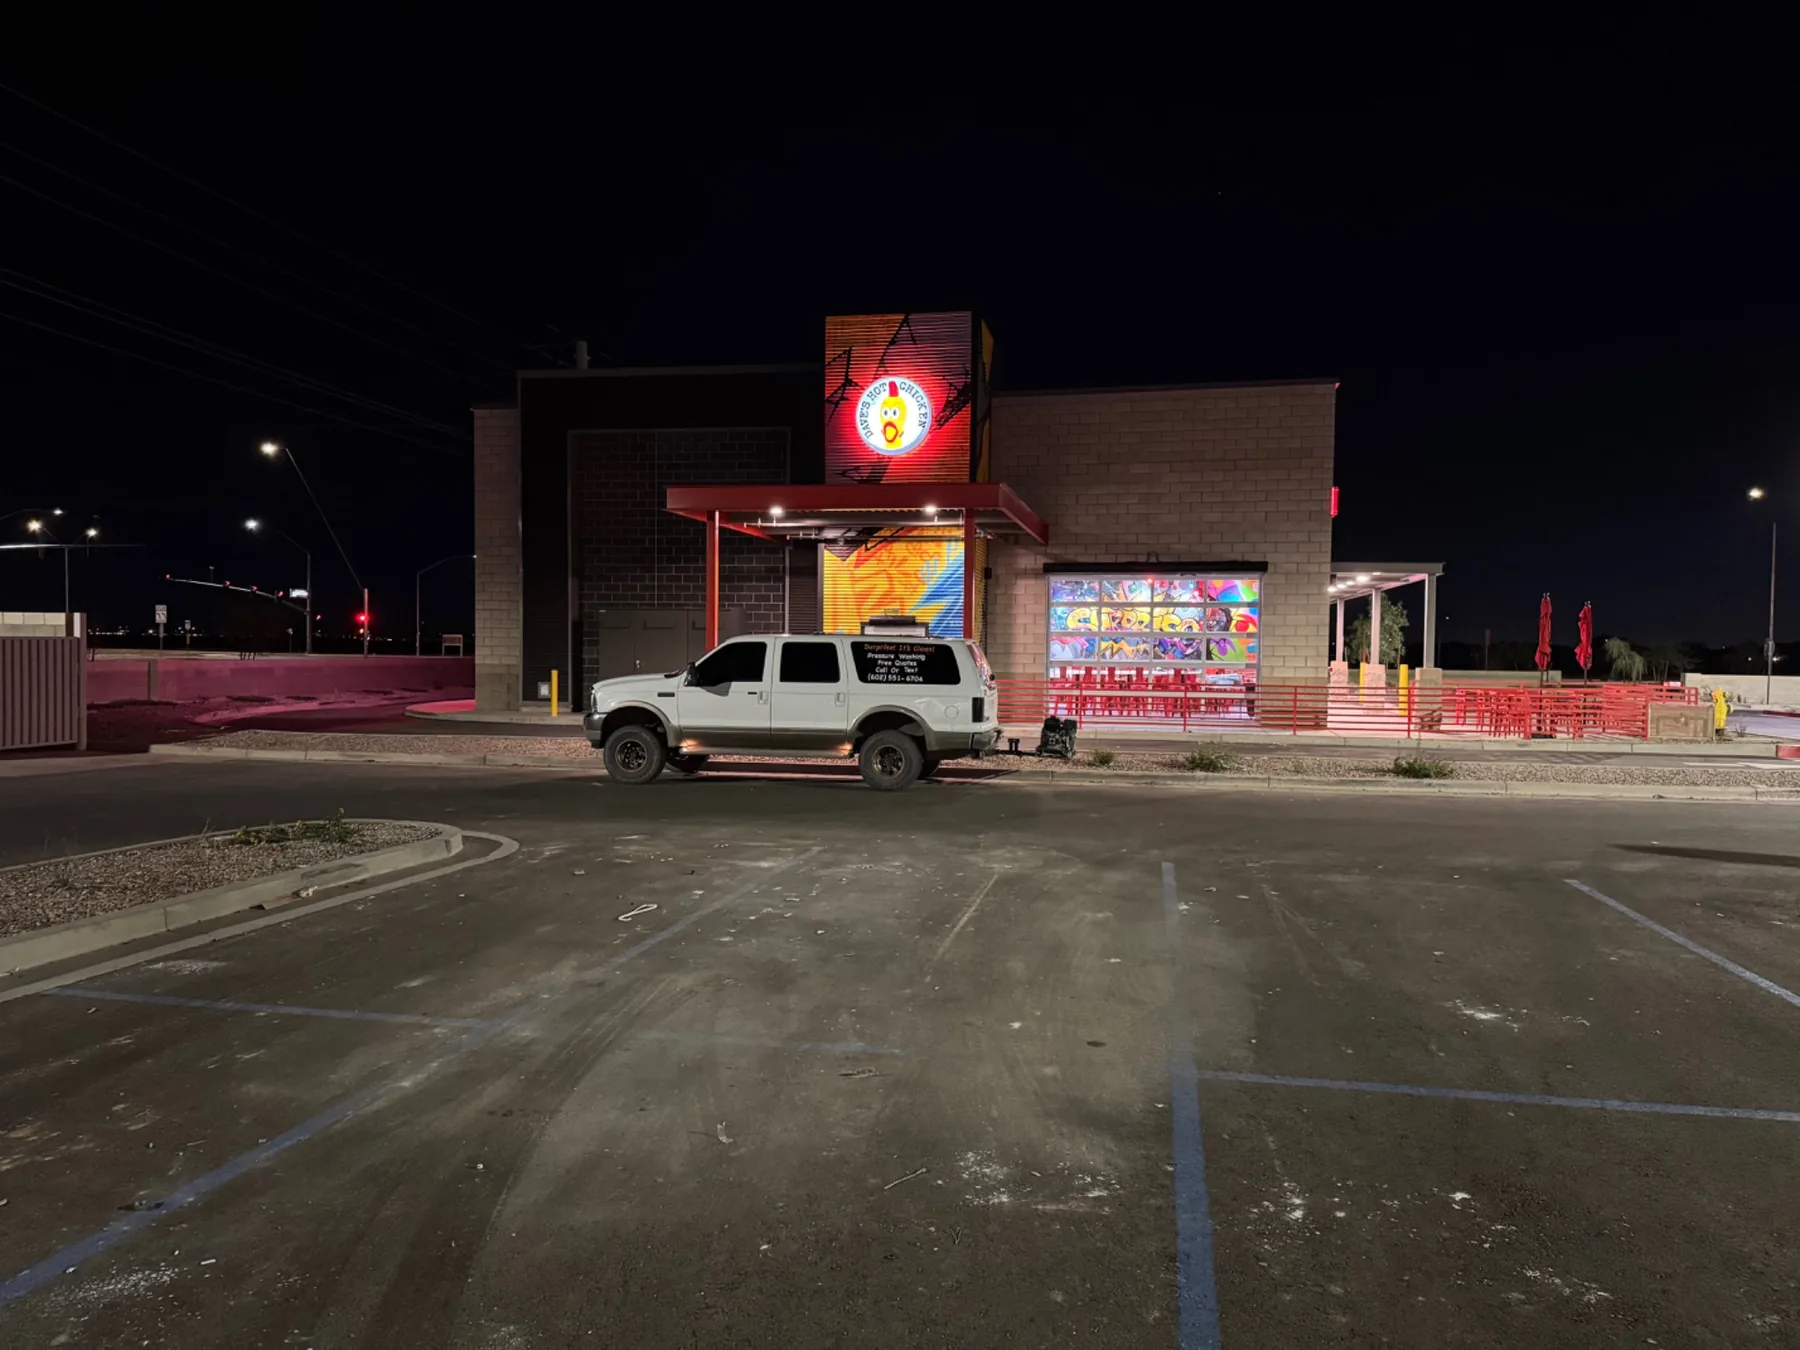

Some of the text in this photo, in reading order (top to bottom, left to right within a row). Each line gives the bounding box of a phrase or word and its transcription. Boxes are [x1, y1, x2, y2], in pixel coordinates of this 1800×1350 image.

[860, 381, 928, 438] DAVE'S HOT CHICKEN
[867, 652, 926, 661] Pressure Washing
